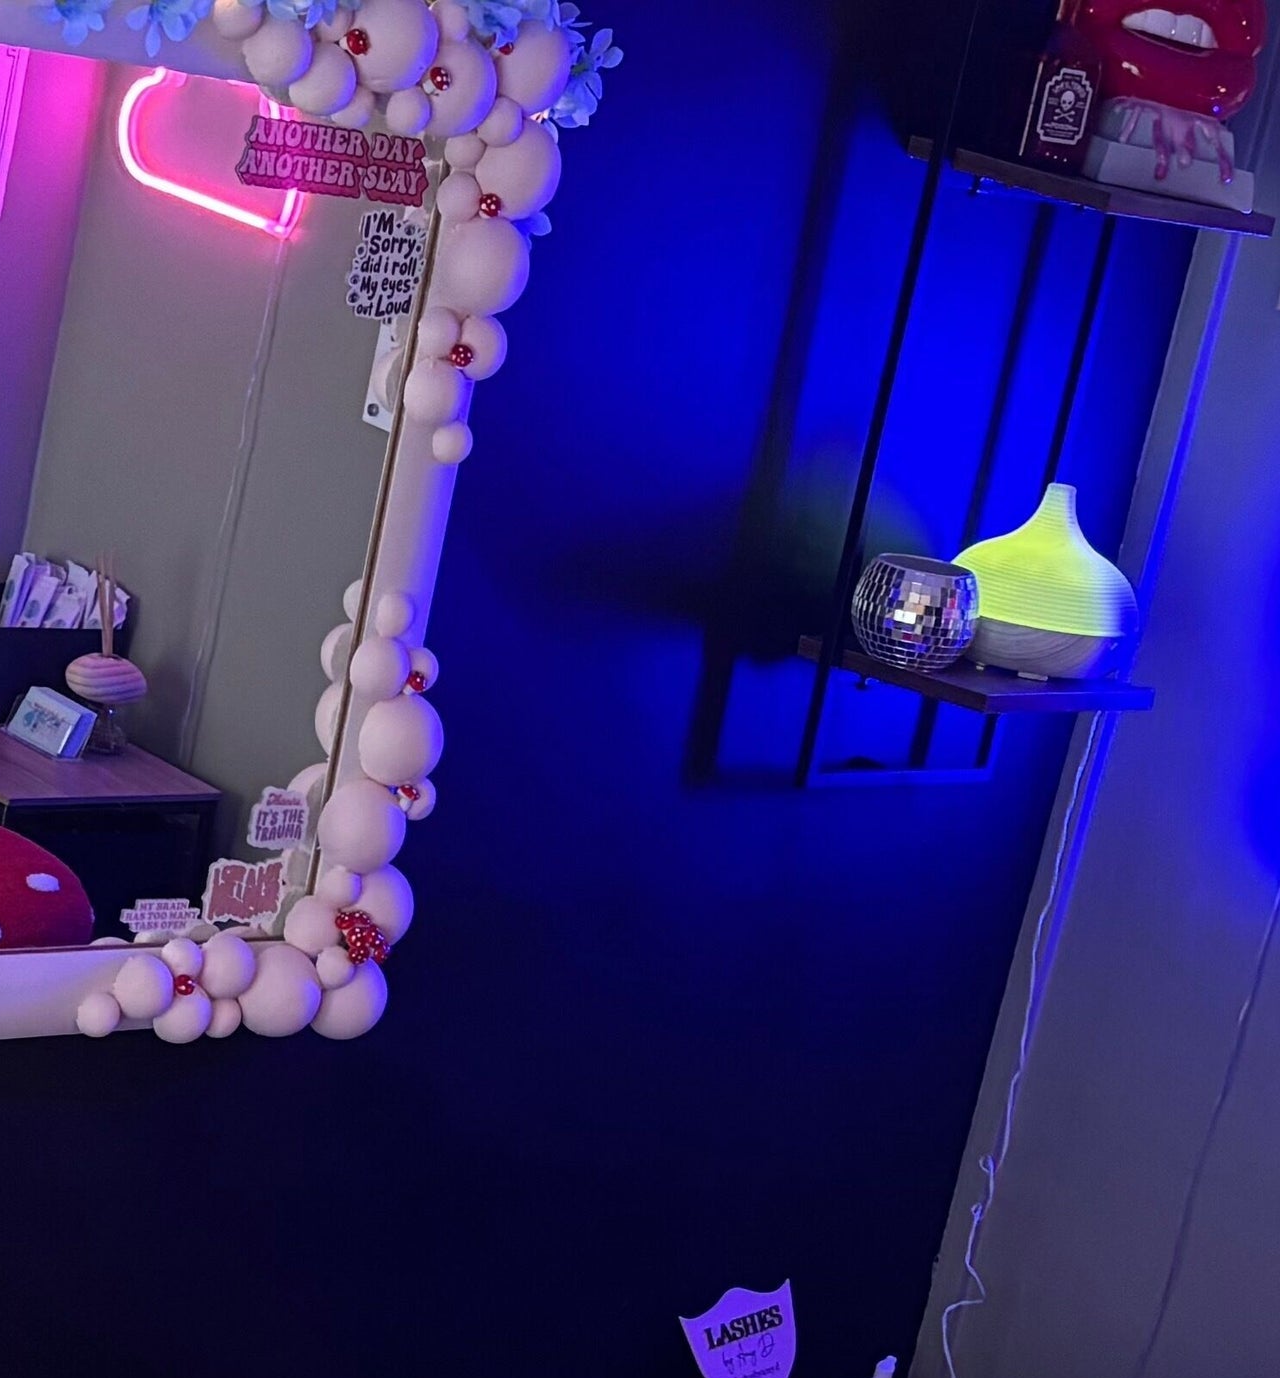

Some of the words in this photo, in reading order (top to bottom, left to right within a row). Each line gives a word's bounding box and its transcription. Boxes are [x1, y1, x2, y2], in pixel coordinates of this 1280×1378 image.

[250, 116, 365, 157] ANOTHER
[239, 149, 358, 187] ANOTHER
[362, 165, 423, 196] SLAY
[362, 212, 395, 239] I'M
[368, 234, 418, 260] Sorry
[360, 254, 383, 275] did
[391, 256, 418, 276] roll
[359, 277, 379, 298] My
[380, 276, 413, 301] eyes
[356, 302, 374, 317] out
[375, 296, 413, 318] Loud
[256, 808, 279, 826] IT'S
[283, 808, 305, 824] THE
[255, 823, 302, 842] TRAUMA
[703, 1304, 784, 1350] LASHES
